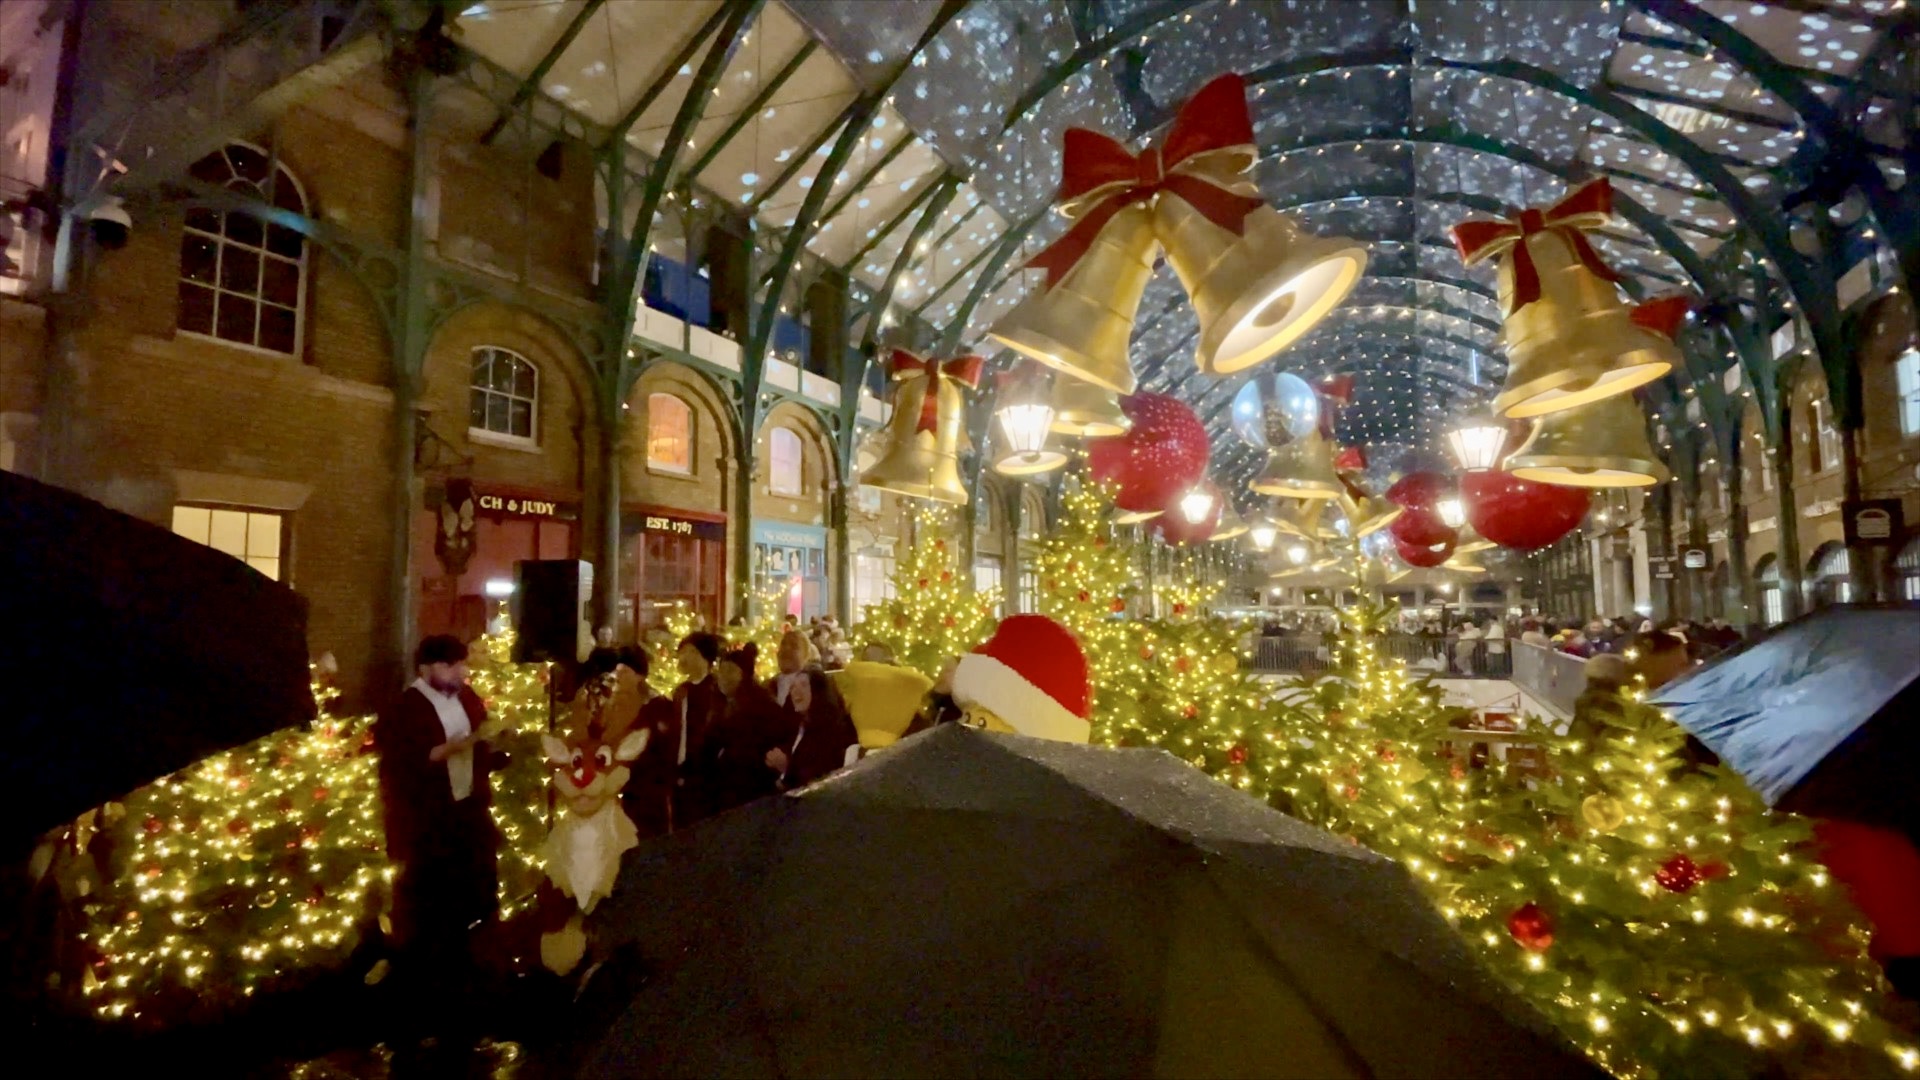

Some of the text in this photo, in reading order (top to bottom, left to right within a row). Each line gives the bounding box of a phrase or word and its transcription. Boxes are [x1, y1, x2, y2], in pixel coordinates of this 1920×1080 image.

[480, 495, 556, 515] CH & JUDY
[672, 521, 692, 535] 1787
